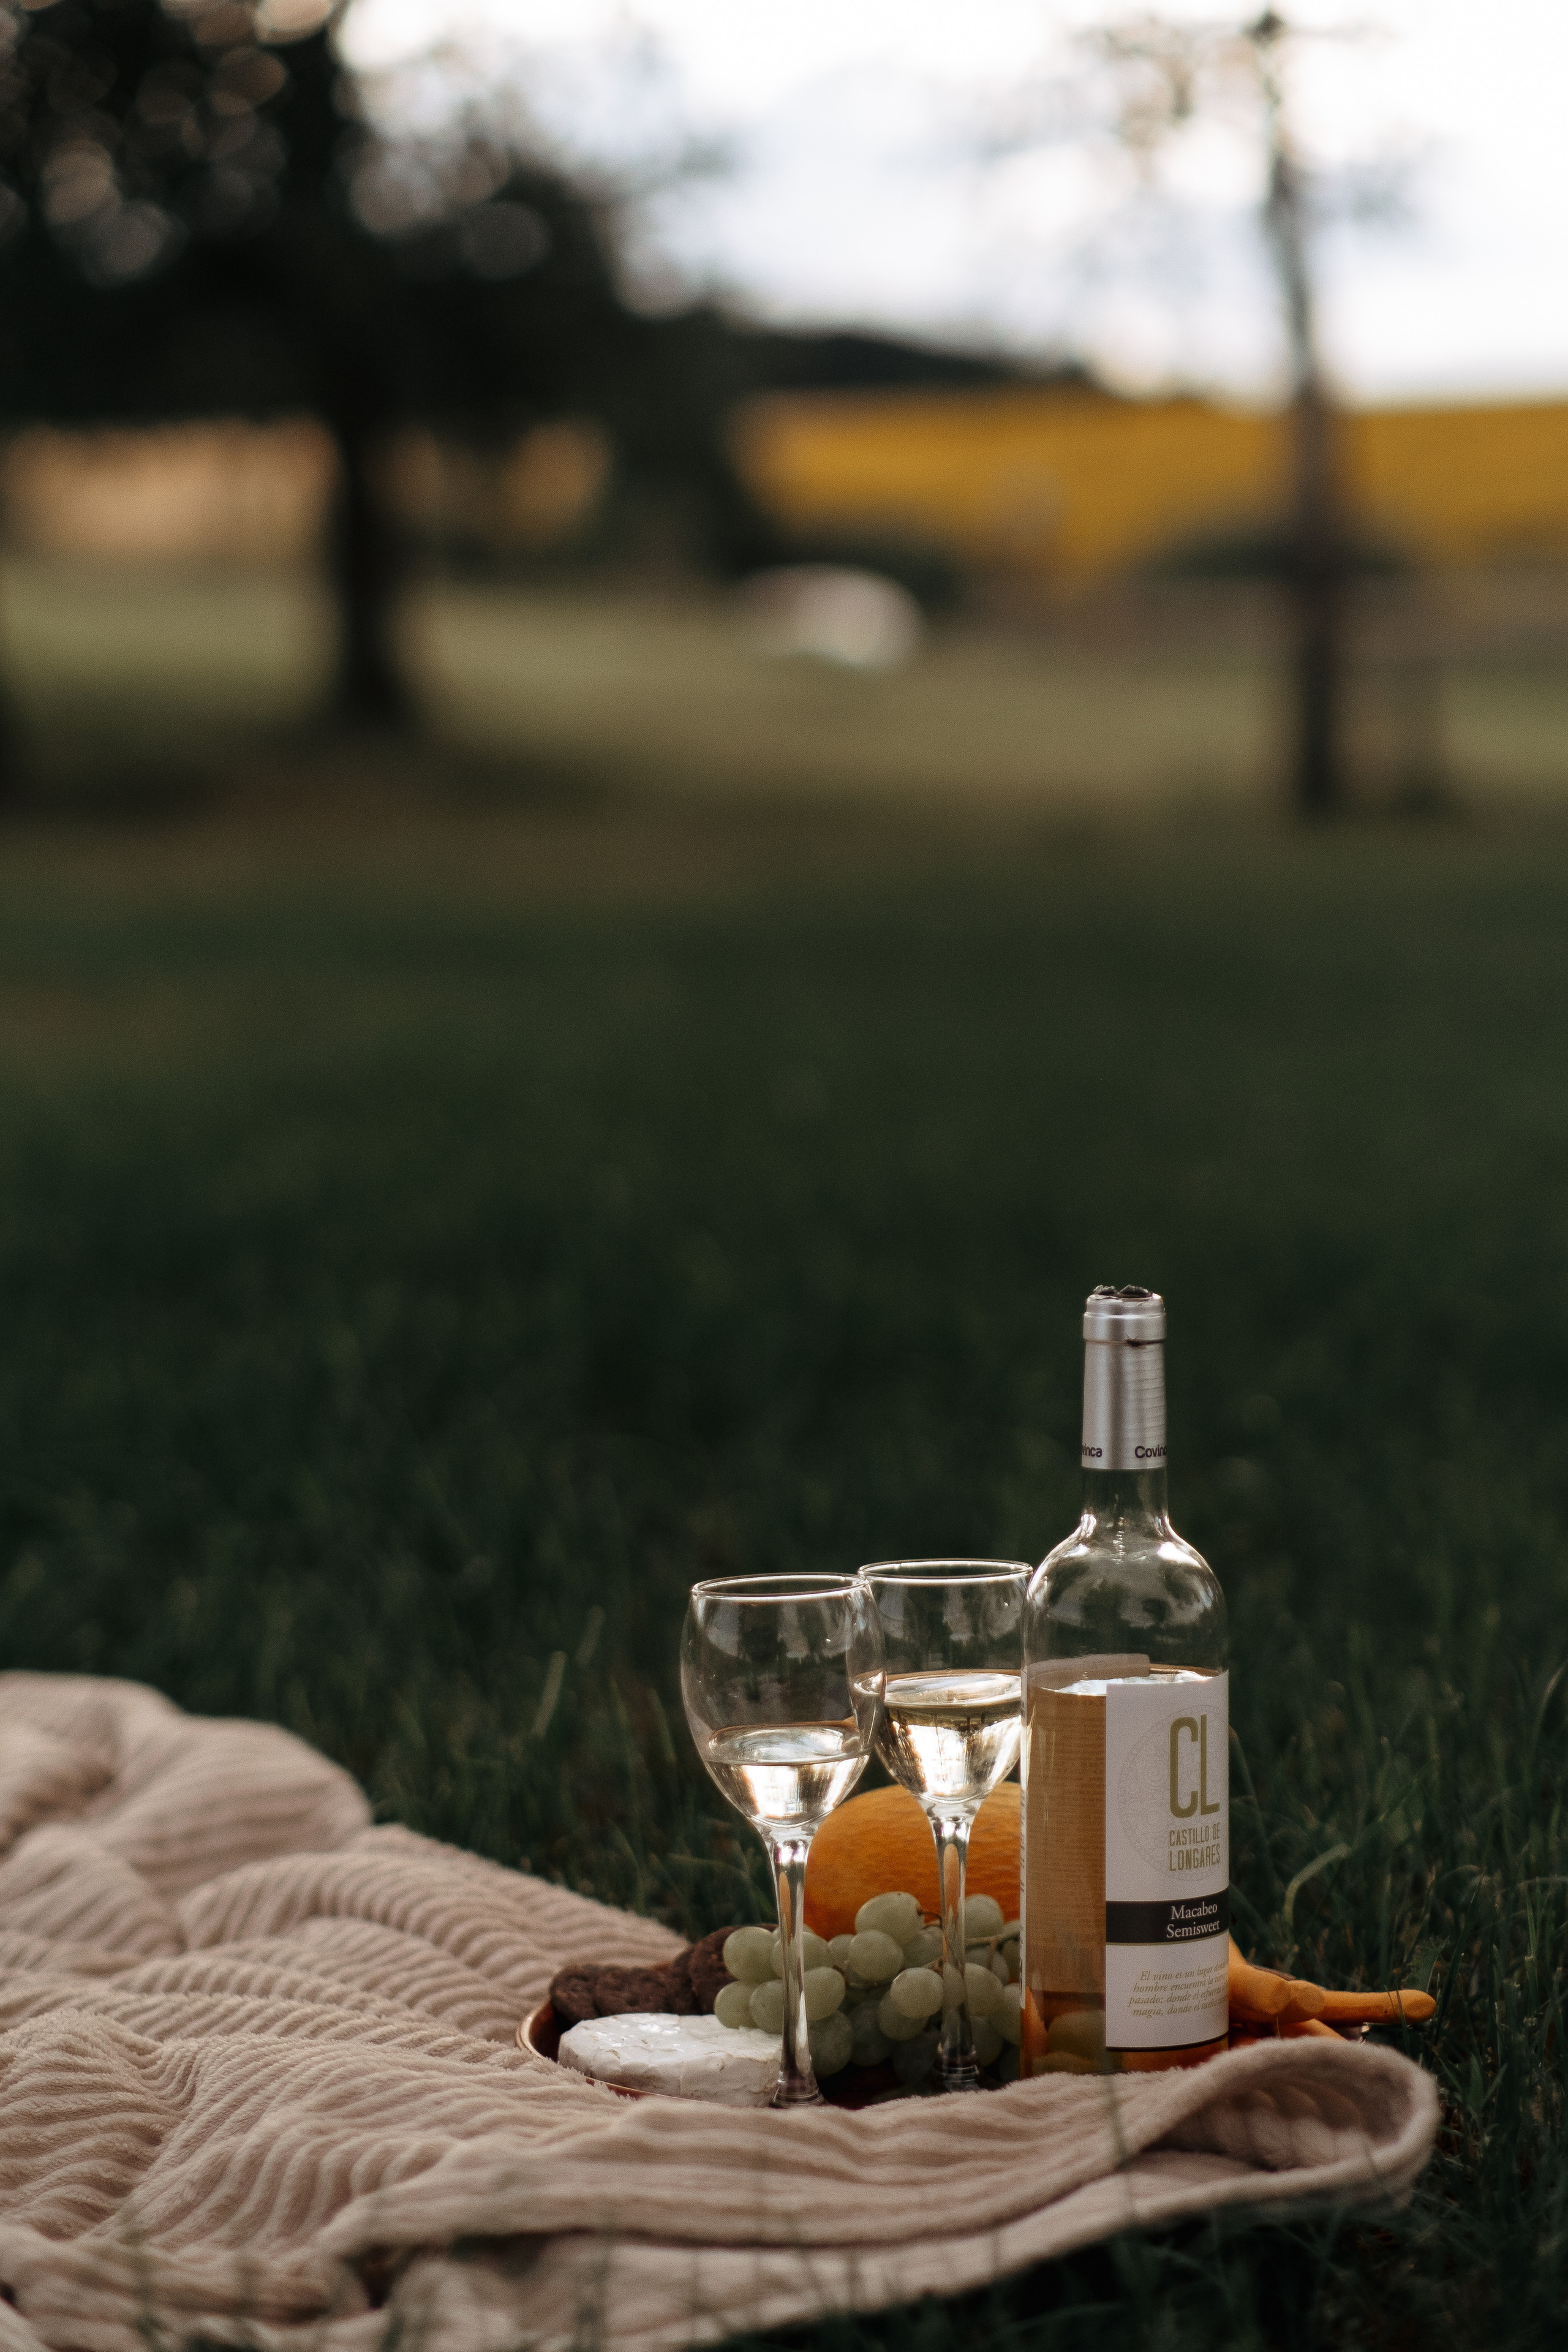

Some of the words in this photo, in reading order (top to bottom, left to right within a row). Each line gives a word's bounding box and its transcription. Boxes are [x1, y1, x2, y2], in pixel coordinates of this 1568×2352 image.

[1170, 1714, 1219, 1818] CL
[1169, 1826, 1209, 1846] CASTILLO
[1213, 1822, 1220, 1840] DE
[1169, 1843, 1220, 1871] LONGARES
[1171, 1901, 1218, 1920] Macabeo
[1166, 1920, 1220, 1938] Semisweet
[1140, 1970, 1151, 1981] El
[1153, 1971, 1172, 1980] vino
[1197, 1965, 1214, 1977] lugar
[1133, 1982, 1168, 1992] hombre
[1170, 1980, 1206, 1991] encuentra
[1166, 1991, 1191, 2003] donde
[1193, 1989, 1199, 2000] el
[1133, 2006, 1164, 2018] magia,
[1167, 2002, 1191, 2015] donde
[1193, 2000, 1199, 2011] el
